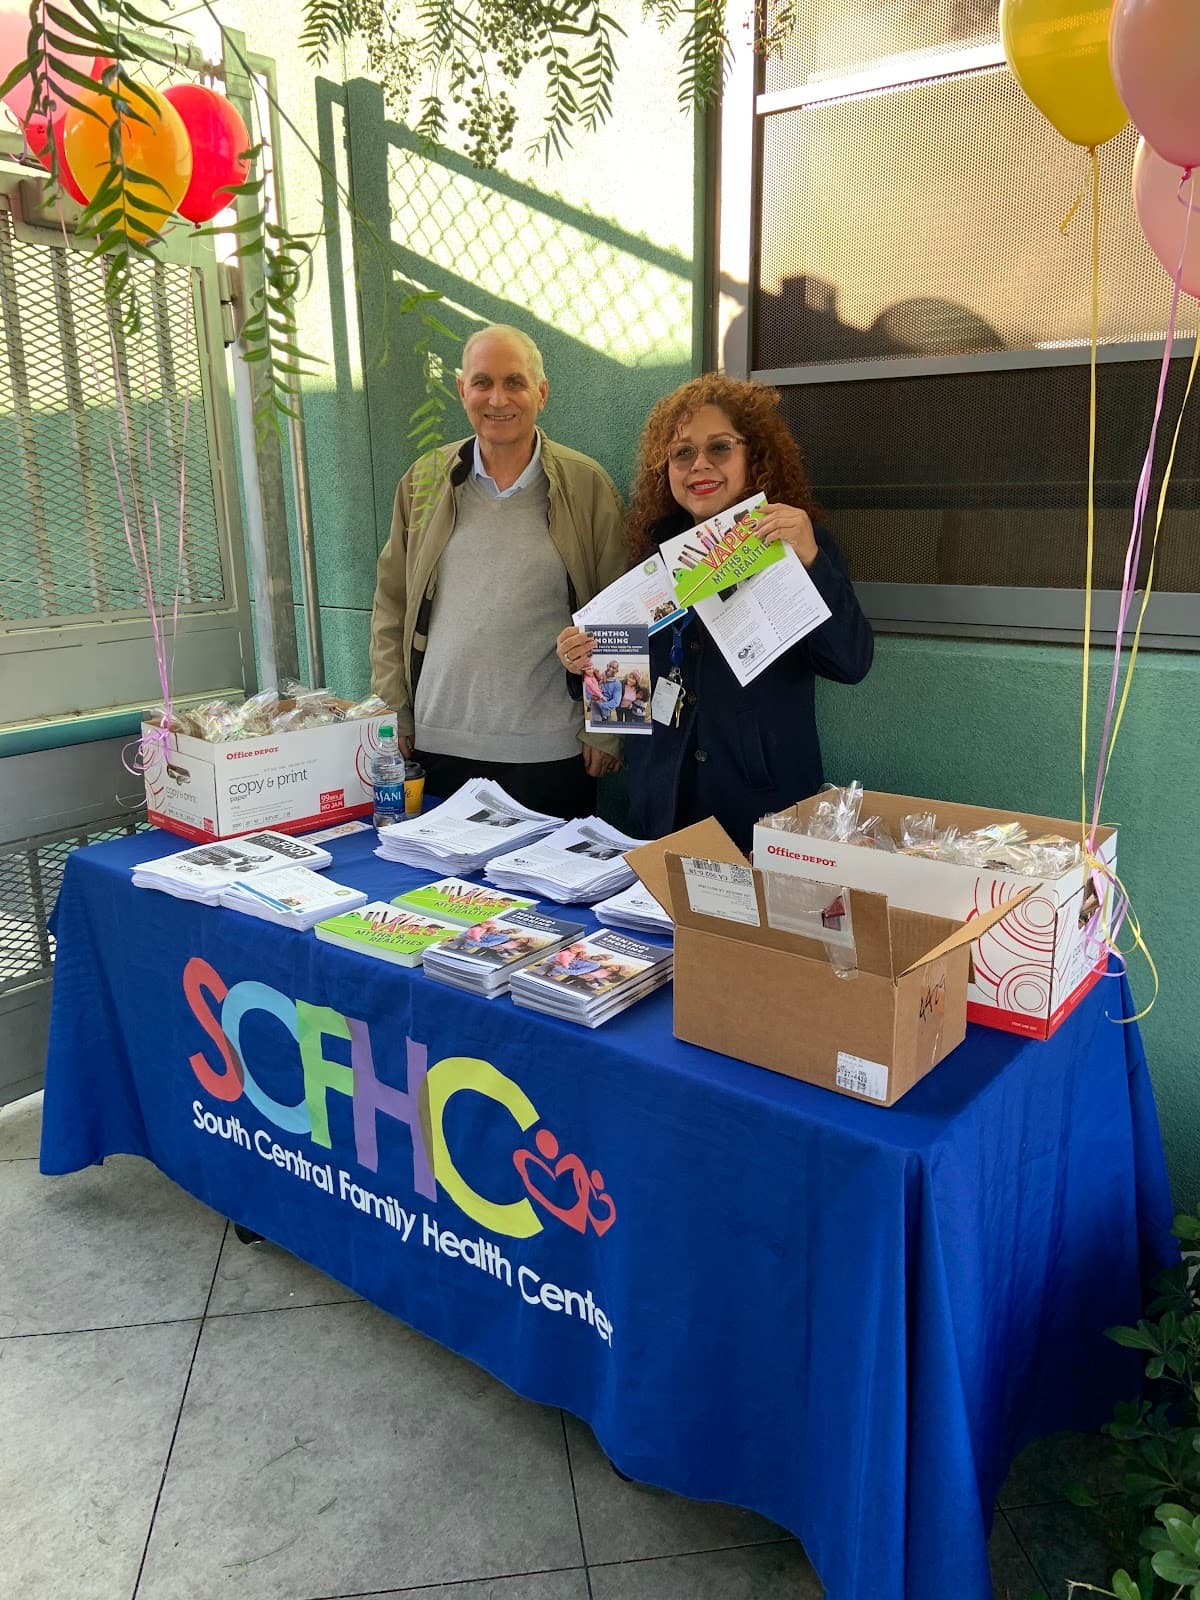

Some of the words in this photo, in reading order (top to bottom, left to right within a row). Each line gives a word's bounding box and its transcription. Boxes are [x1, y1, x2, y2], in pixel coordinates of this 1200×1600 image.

[702, 513, 758, 569] VAPES
[712, 554, 741, 584] MYTHS
[741, 545, 752, 555] &
[226, 752, 253, 760] Office
[254, 747, 279, 756] DEPOT
[229, 779, 265, 796] copy
[266, 777, 275, 788] &
[277, 769, 308, 789] print
[375, 790, 402, 803] ASANI
[275, 841, 311, 856] FOOD
[767, 845, 801, 860] Office
[802, 854, 837, 867] DEPOT
[354, 930, 392, 938] MYTHS
[371, 921, 438, 936] VAPES
[368, 937, 424, 946] REALITIES
[608, 934, 650, 951] MENTHOL
[183, 957, 543, 1238] SCFHC
[193, 1100, 251, 1150] South
[254, 1130, 334, 1195] Central
[339, 1170, 416, 1242] Family
[423, 1212, 512, 1288] Health
